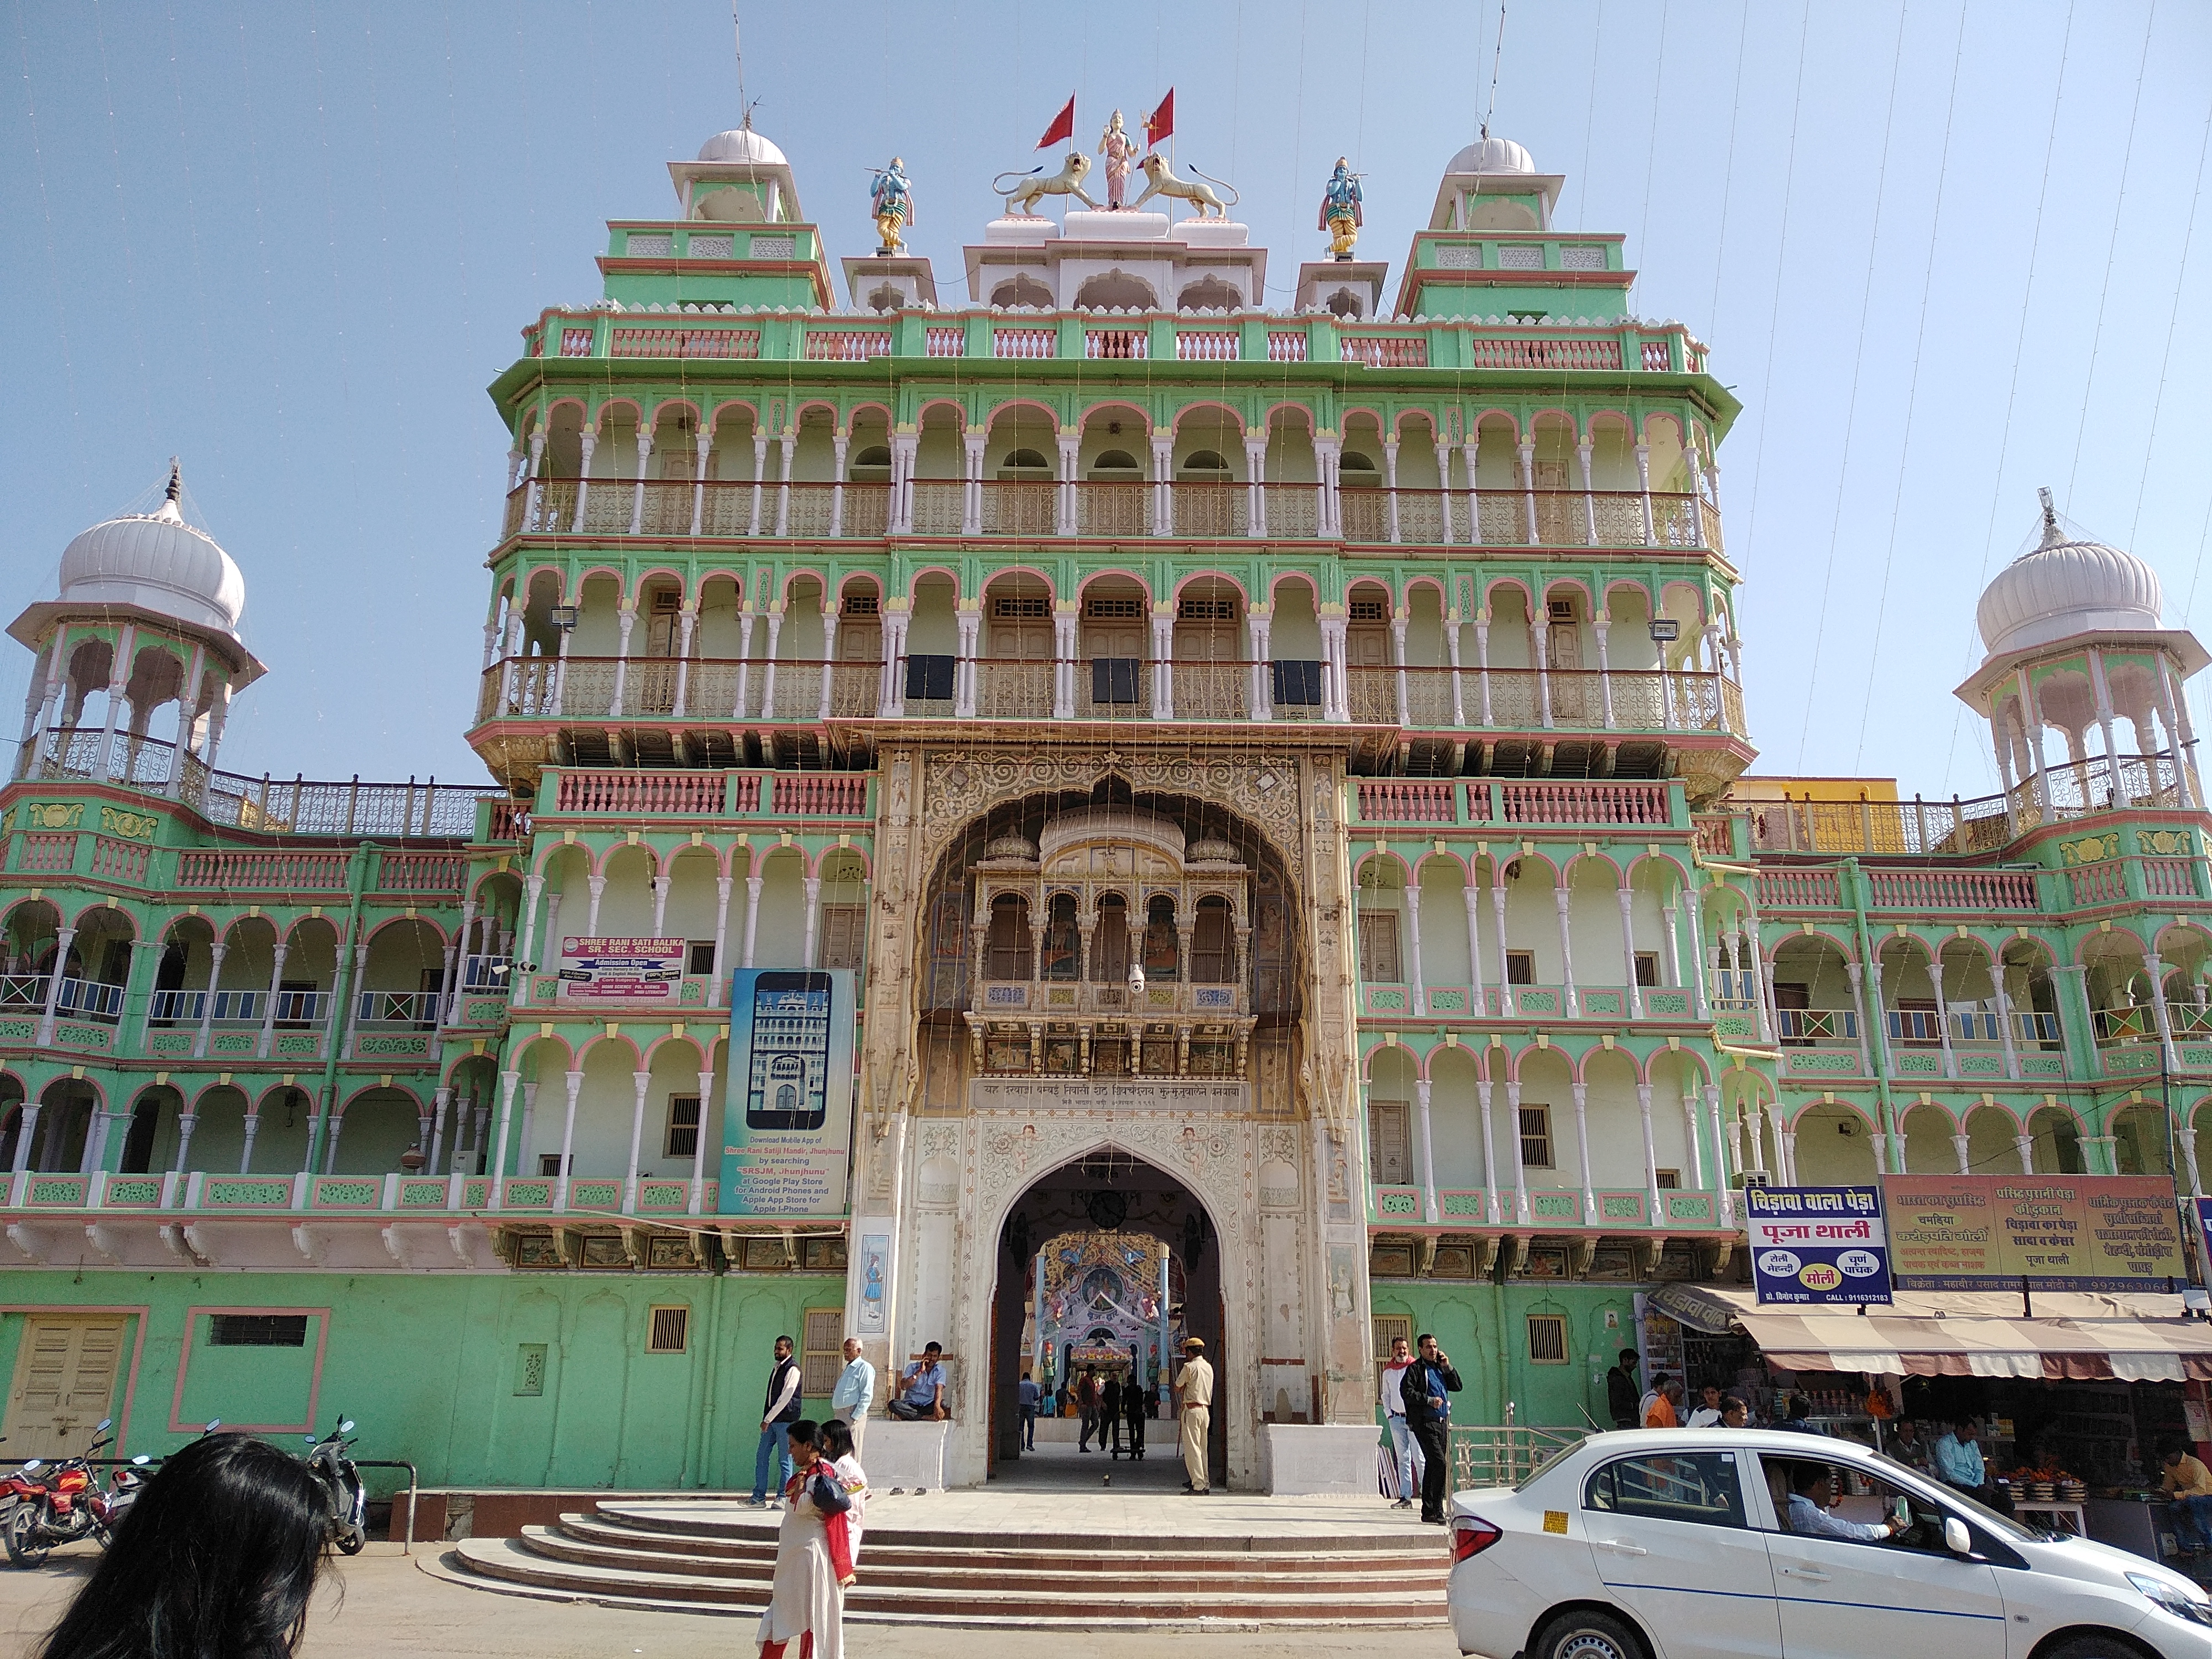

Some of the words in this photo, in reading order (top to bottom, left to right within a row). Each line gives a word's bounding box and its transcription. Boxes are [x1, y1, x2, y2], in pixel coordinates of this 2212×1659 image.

[984, 1086, 999, 1094] यह
[1004, 1086, 1032, 1095] दरवाजा
[1064, 1084, 1089, 1095] निवासी
[764, 1147, 781, 1155] Satiji
[783, 1147, 807, 1155] Mandir,
[810, 1147, 844, 1156] Jhunjhunu
[759, 1157, 768, 1165] by
[771, 1157, 810, 1165] searching
[753, 1178, 780, 1186] Google
[782, 1178, 800, 1186] Play
[1897, 1195, 1926, 1206] भारत
[1926, 1195, 1944, 1206] का
[2025, 1186, 2056, 1202] पुरानी
[2056, 1186, 2077, 1203] पेड़ा
[1750, 1190, 1803, 1215] चिड़ावा
[1804, 1193, 1844, 1211] वाला
[1845, 1188, 1875, 1215] पेड़ा
[2088, 1194, 2119, 1208] धार्मिक
[2119, 1197, 2148, 1212] पुस्तक
[2012, 1201, 2030, 1215] की
[2030, 1204, 2063, 1219] दुकान
[2005, 1217, 2041, 1233] चिड़ावा
[2041, 1220, 2057, 1230] का
[2057, 1217, 2078, 1233] पेड़ा
[1761, 1225, 1811, 1244] पूजा
[1815, 1220, 1871, 1239] थाली
[1955, 1228, 1989, 1242] गोली
[2095, 1229, 2136, 1240] राजस्थान
[2136, 1227, 2152, 1240] की
[2012, 1236, 2038, 1246] सादा
[2038, 1237, 2047, 1246] व
[2047, 1233, 2075, 1246] केसर
[1770, 1254, 1788, 1262] रोली
[1848, 1254, 1867, 1266] चूर्ण
[1903, 1260, 1926, 1269] पाचक
[1927, 1259, 1940, 1270] एवं
[1961, 1261, 1985, 1269] नाशक
[2025, 1255, 2045, 1267] पूजा
[2047, 1253, 2070, 1265] थाली
[1767, 1264, 1793, 1273] मेहन्दी
[1844, 1266, 1873, 1274] पाचक
[1805, 1269, 1835, 1285] मोली
[1907, 1277, 1936, 1289] विक्रेता
[1943, 1278, 1973, 1289] महावीर
[2045, 1279, 2065, 1290] मोदी
[1776, 1292, 1793, 1301] विनोद
[1793, 1293, 1810, 1303] कुमार
